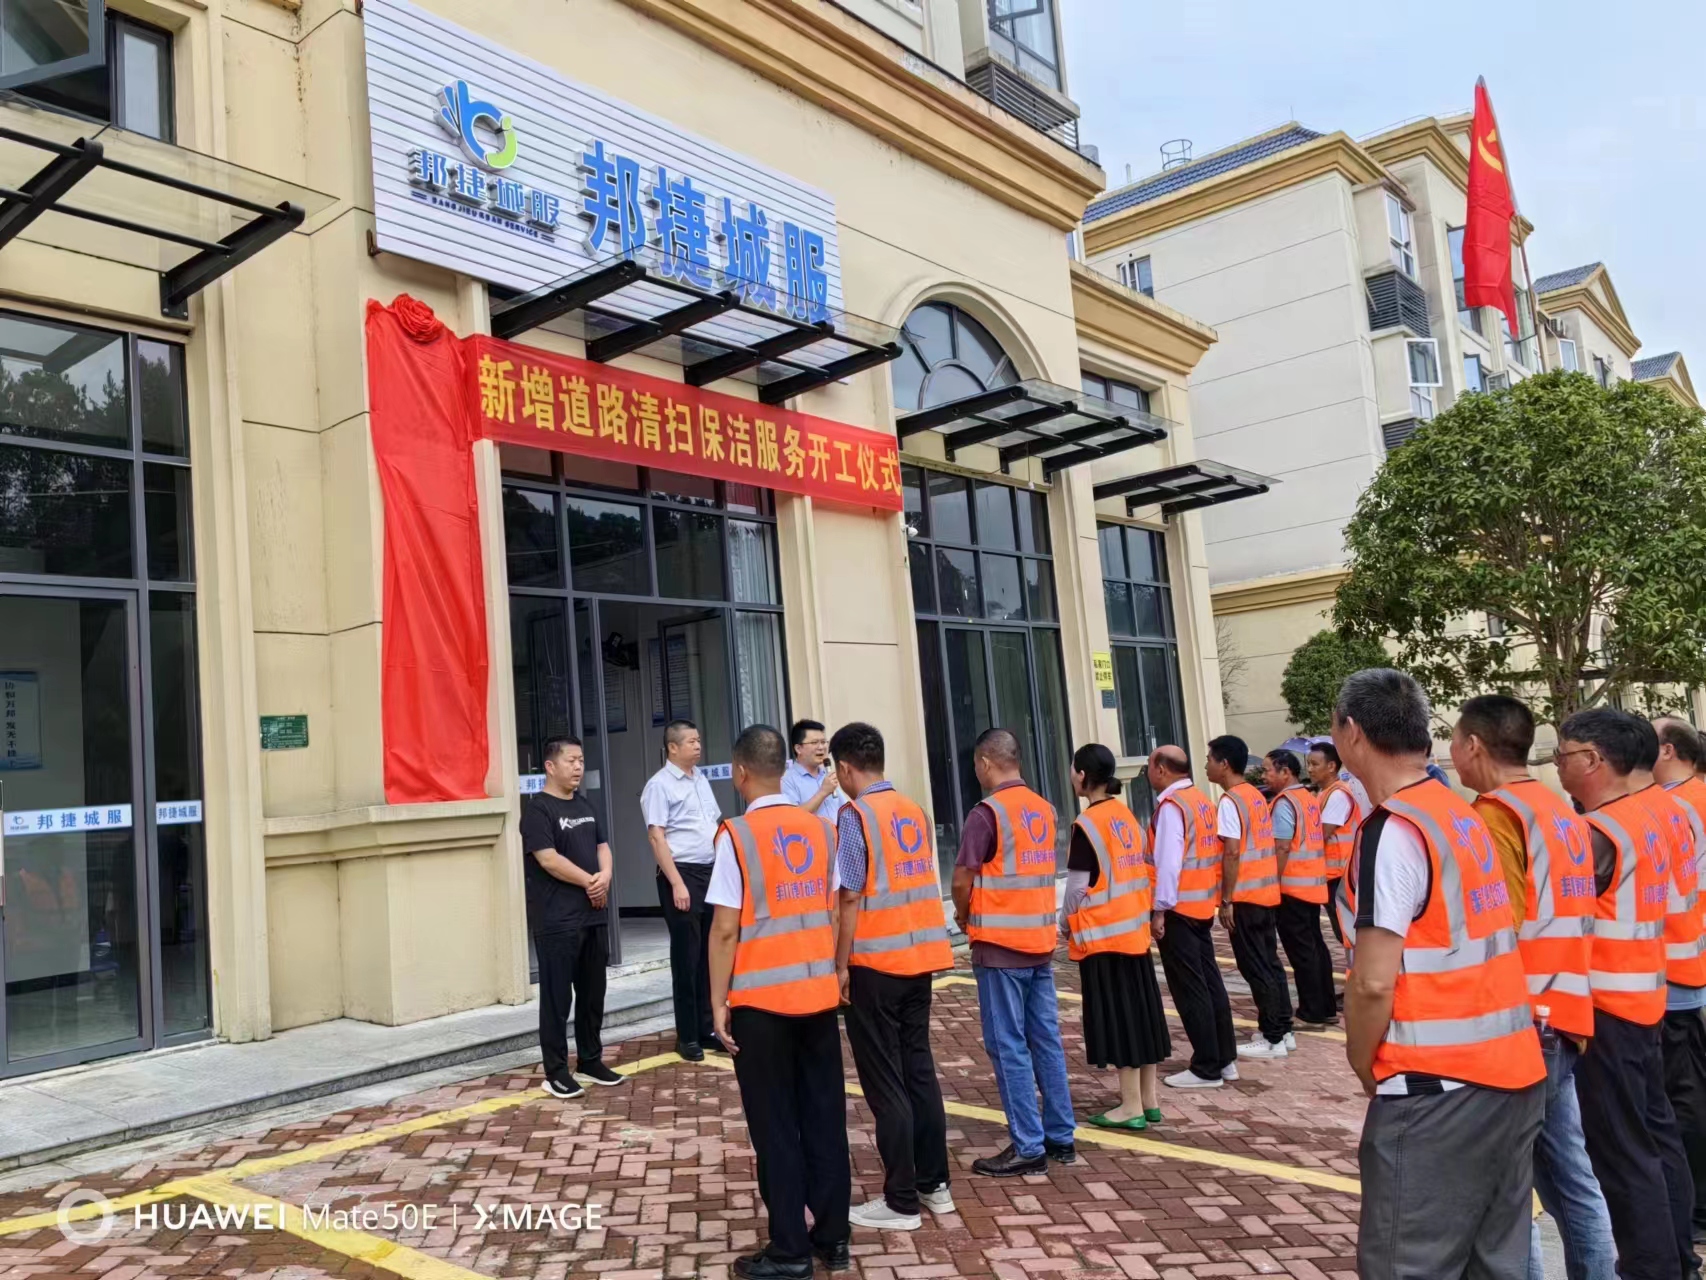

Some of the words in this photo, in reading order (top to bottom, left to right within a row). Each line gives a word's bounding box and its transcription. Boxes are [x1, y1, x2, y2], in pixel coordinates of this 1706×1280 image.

[414, 150, 560, 227] 邦捷城服
[504, 220, 539, 239] SERVICE
[580, 139, 835, 324] 邦捷城服
[478, 354, 902, 497] 新增道路清扫保洁服务开工仪式
[37, 809, 123, 830] 邦捷城服
[158, 805, 198, 820] 邦捷城服
